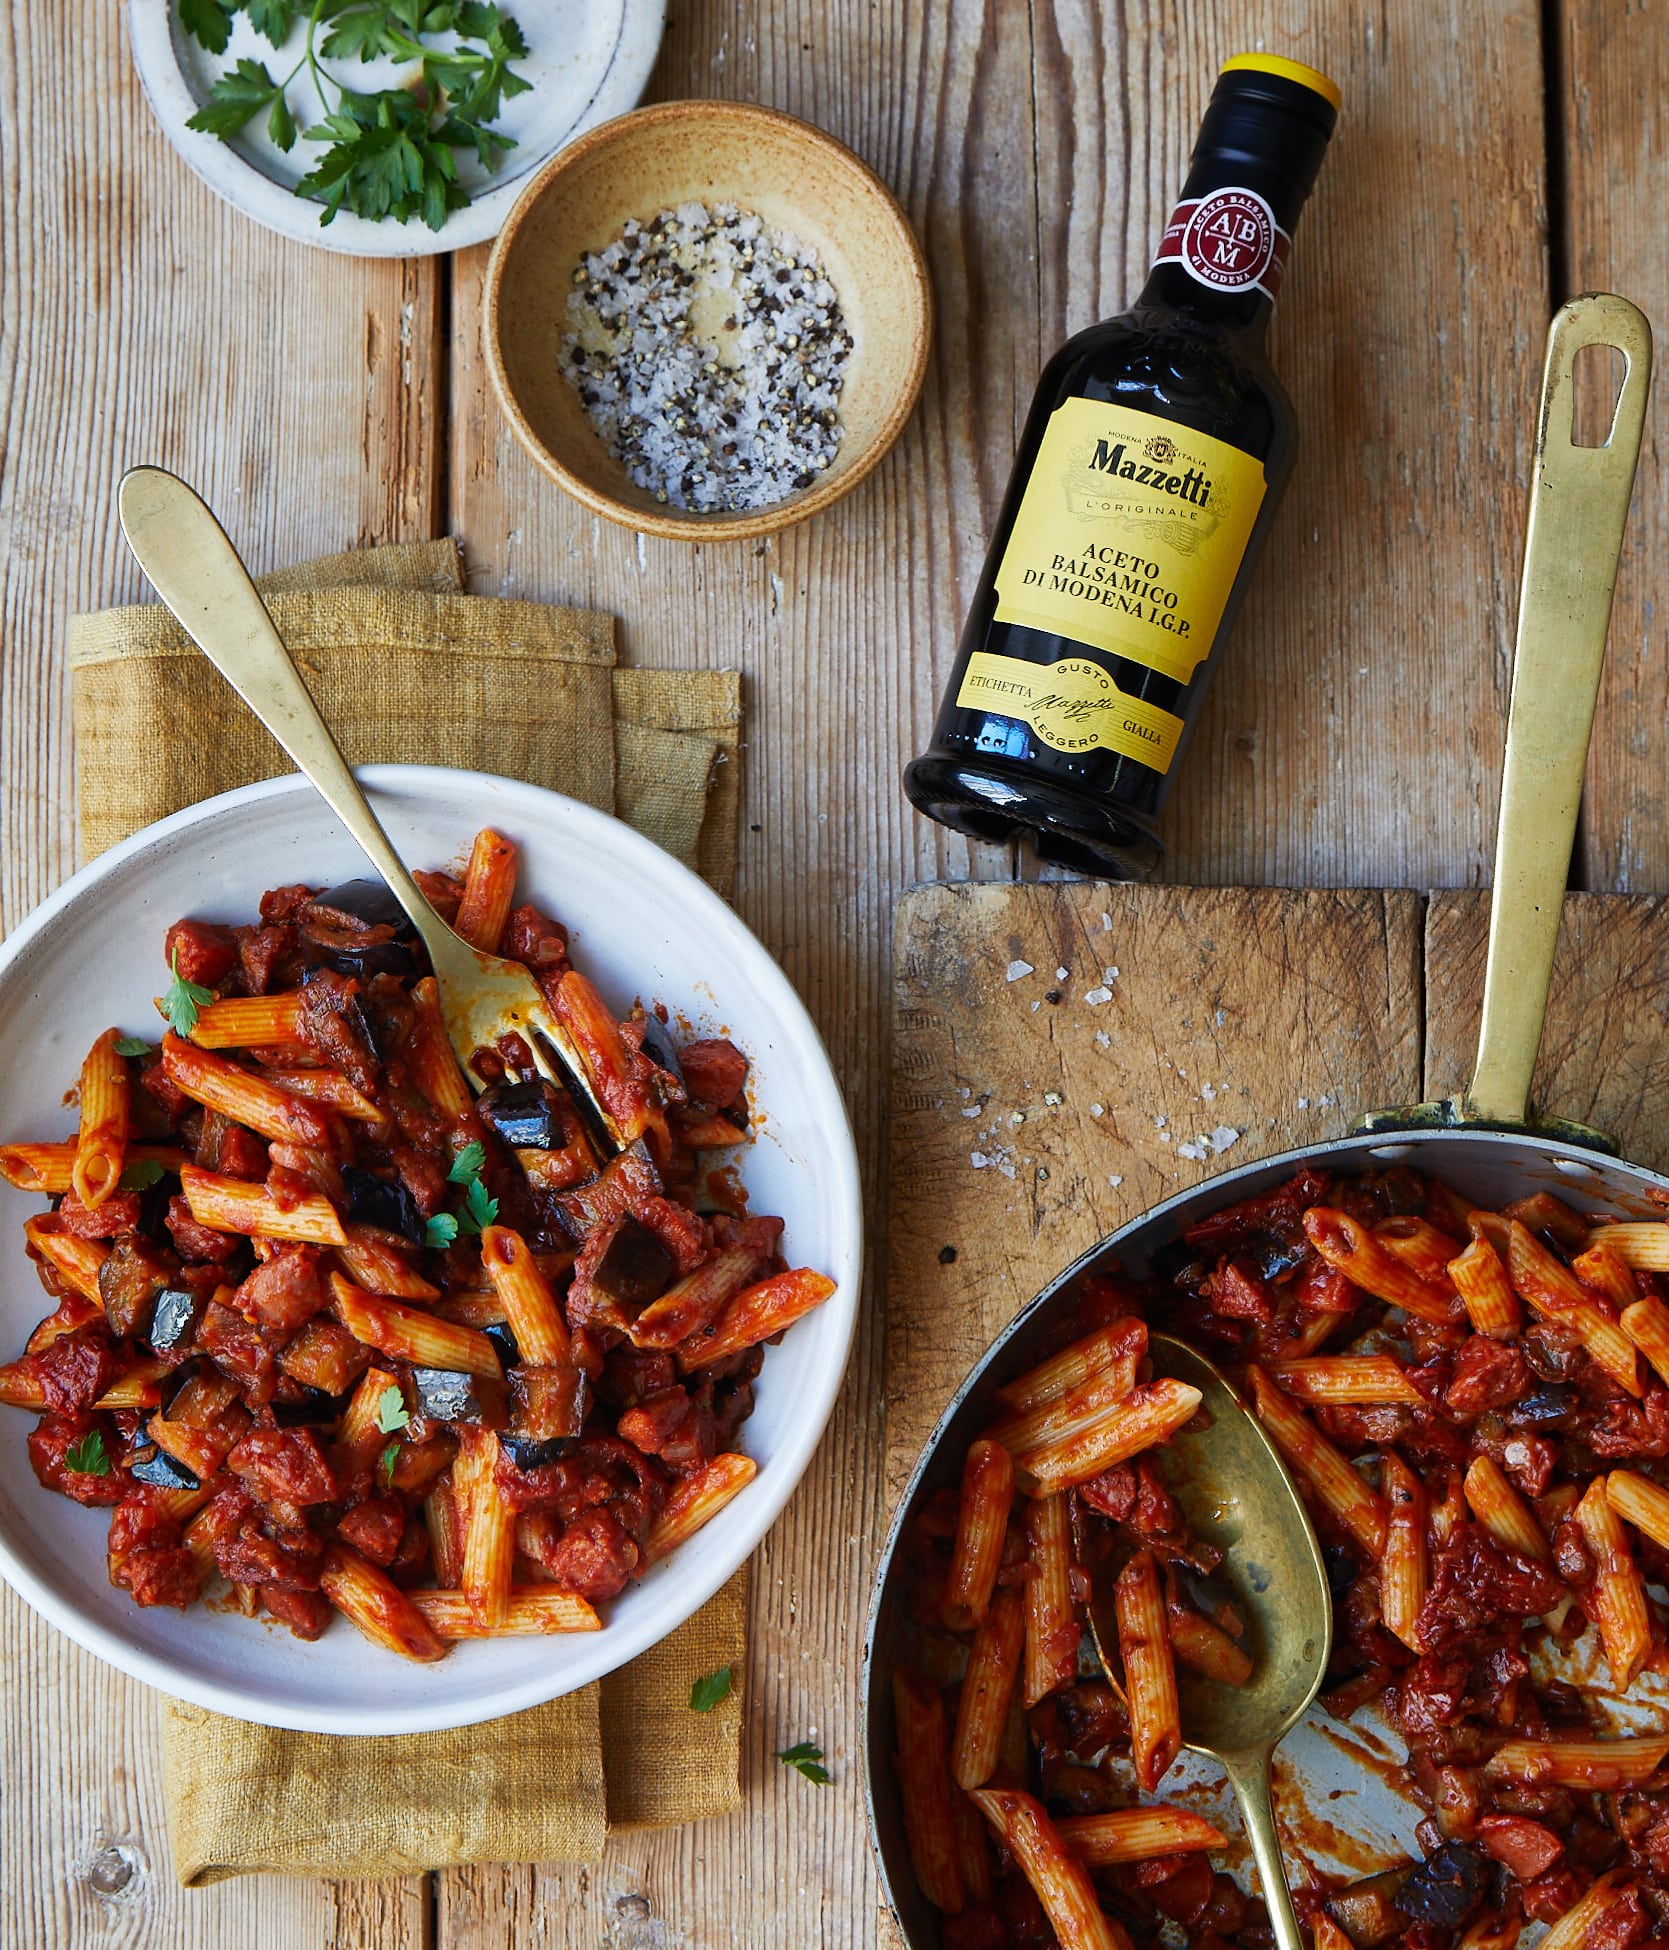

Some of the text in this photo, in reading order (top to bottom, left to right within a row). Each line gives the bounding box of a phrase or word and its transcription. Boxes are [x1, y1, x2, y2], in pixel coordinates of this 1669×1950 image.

[1193, 196, 1270, 253] ACETO BALSAMICO
[1209, 212, 1230, 235] A
[1238, 218, 1257, 242] B
[1212, 240, 1240, 268] M
[1200, 266, 1251, 285] MODENA
[1108, 430, 1207, 468] MODENA ITALIA
[1088, 438, 1212, 508] Mazzetti
[1086, 500, 1199, 520] L'ORIGINALE
[1082, 543, 1160, 580] ACETO
[1051, 554, 1178, 609] BALSAMICO
[1022, 569, 1191, 639] DI MODENA I.G.P.
[969, 675, 1033, 698] ETICHETTA
[1057, 664, 1109, 690] GUSTO
[1032, 715, 1099, 748] LEGGERO
[1122, 719, 1162, 745] GIALLA
